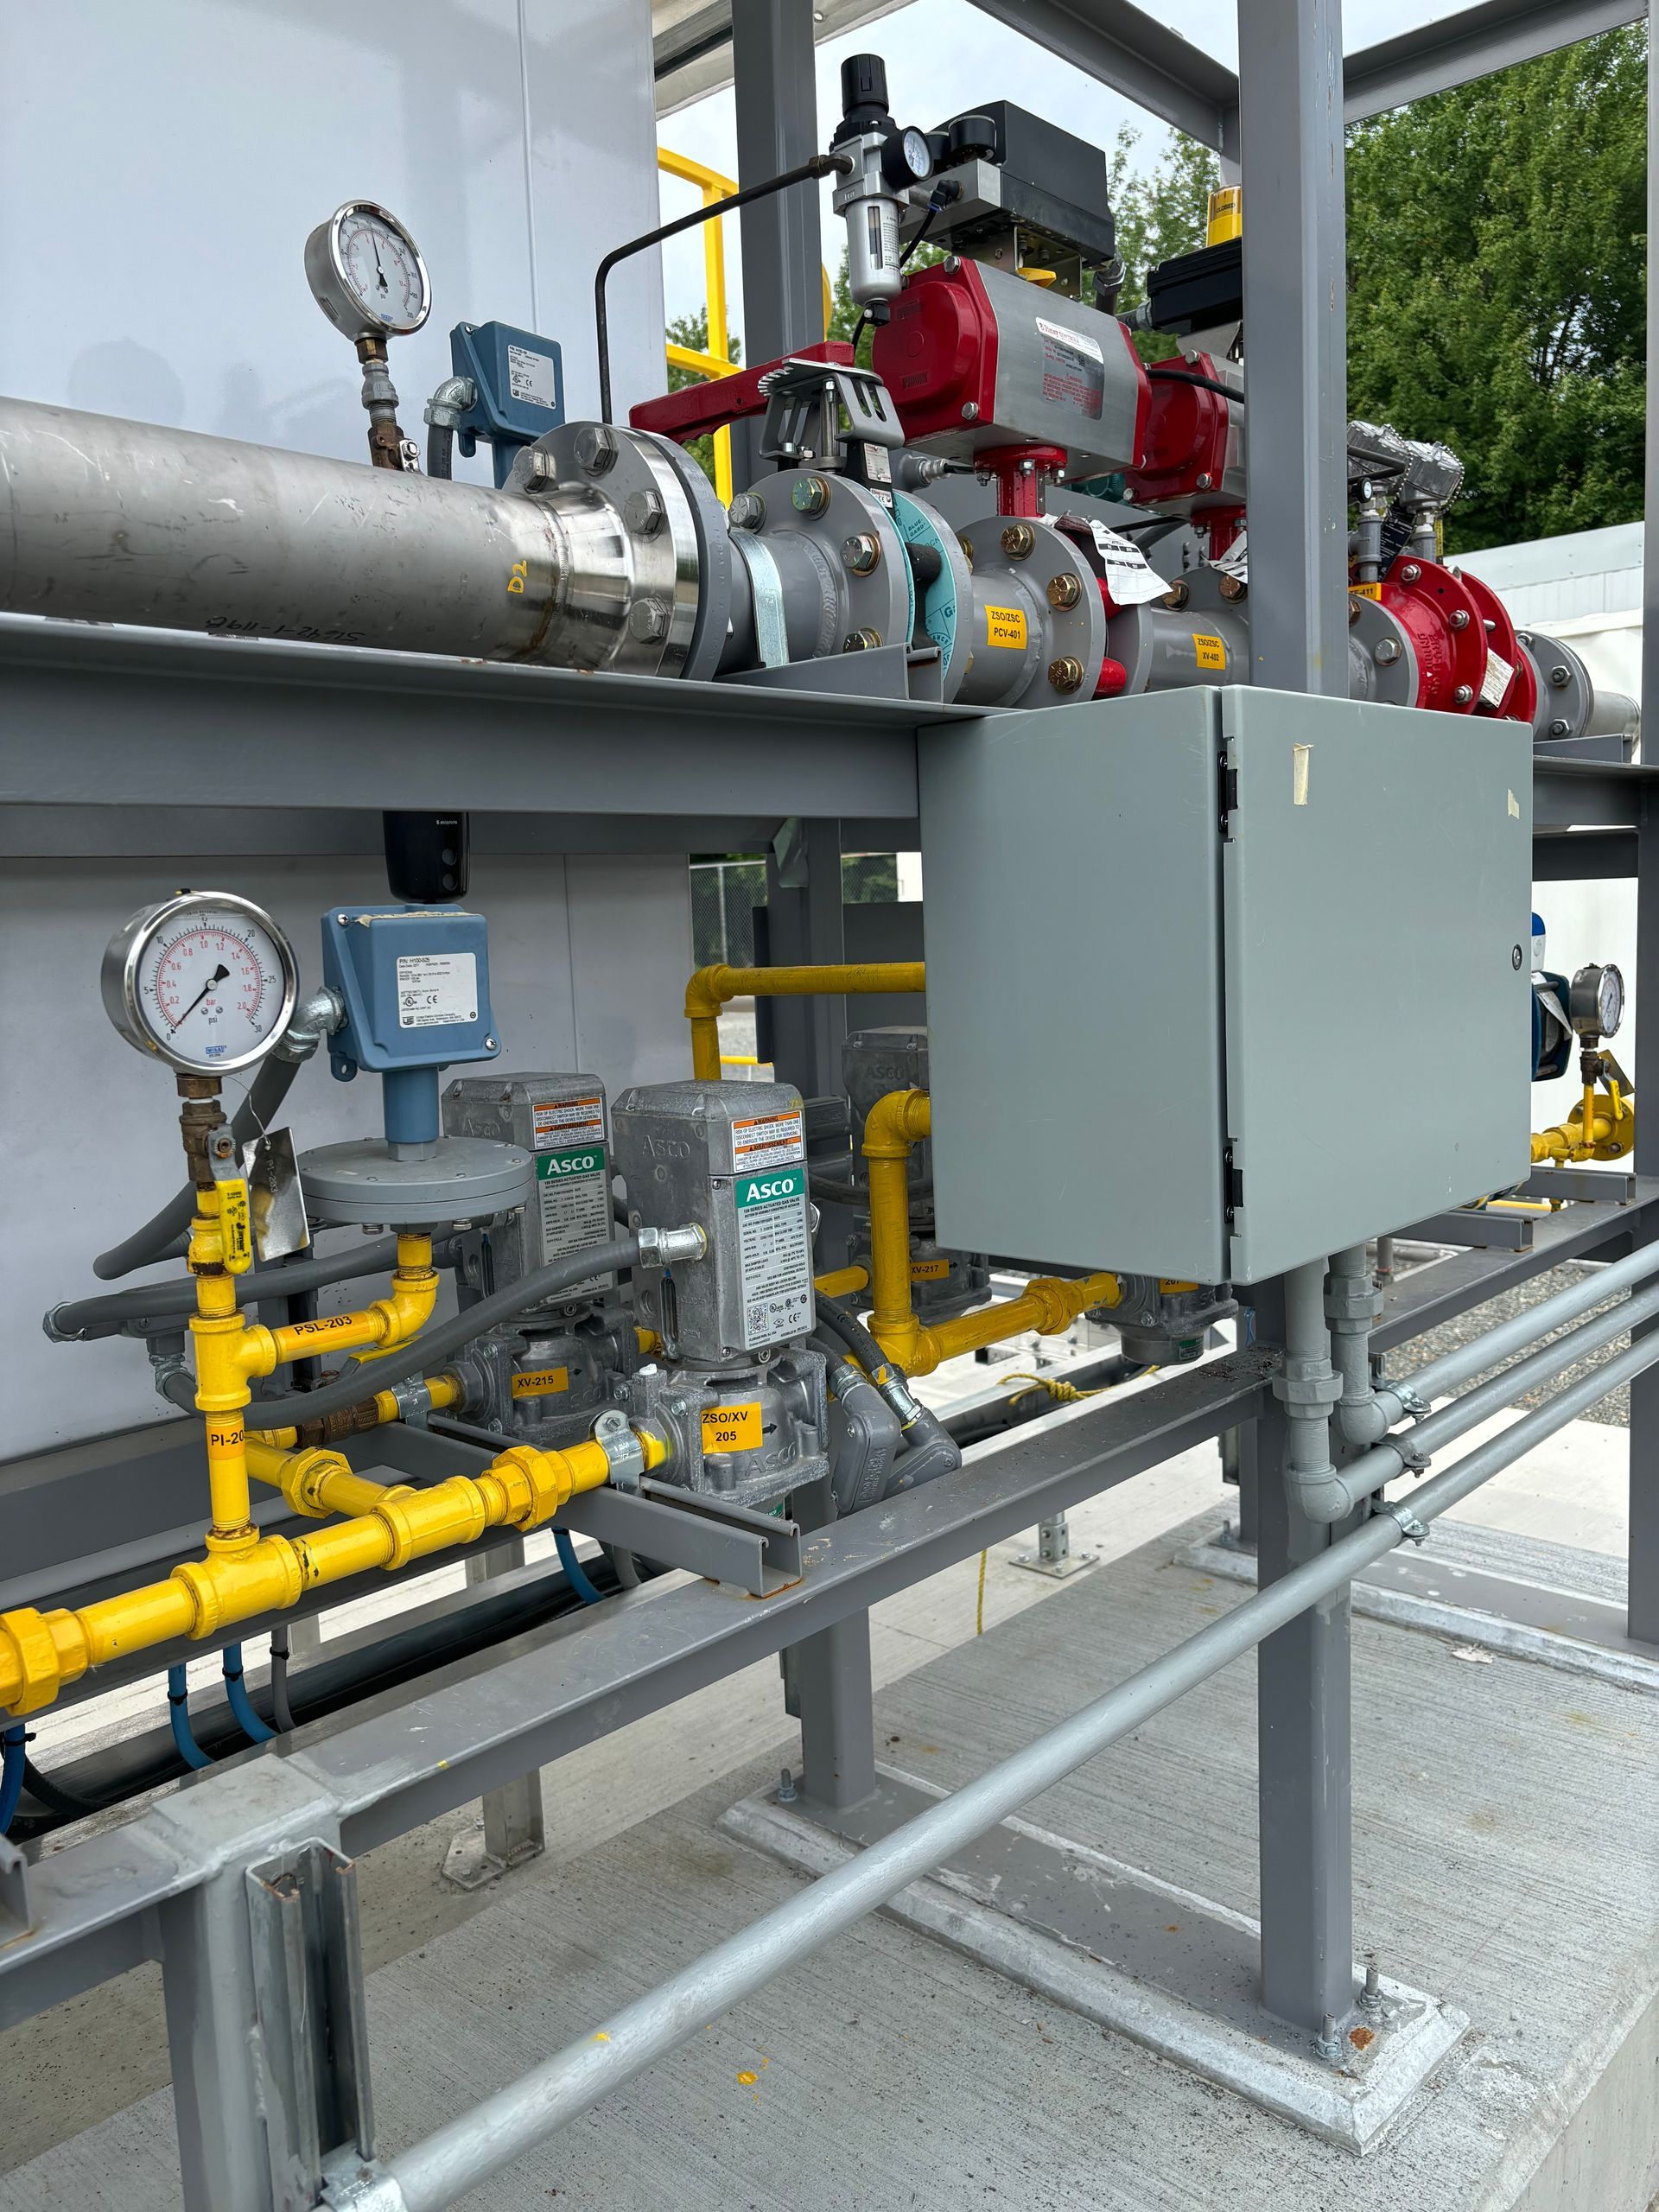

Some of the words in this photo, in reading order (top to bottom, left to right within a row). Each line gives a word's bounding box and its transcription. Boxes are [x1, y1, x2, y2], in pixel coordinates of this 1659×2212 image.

[990, 611, 1020, 623] ZSO/ZSC
[994, 627, 1020, 639] PCV-401
[156, 936, 164, 944] 10
[241, 967, 250, 976] 1.6
[167, 980, 176, 988] 0.4
[208, 1015, 218, 1025] psi
[255, 1024, 262, 1033] 30
[166, 1033, 171, 1041] 0
[643, 1135, 690, 1159] ASCO
[547, 1156, 594, 1175] ASCO
[746, 1179, 794, 1202] ASCO
[912, 1265, 939, 1274] XV-217
[294, 1316, 353, 1335] PSL-203
[518, 1376, 554, 1388] XV-215
[702, 1411, 748, 1424] ZSO/XV
[211, 1430, 245, 1446] PI-20
[715, 1431, 736, 1441] 205
